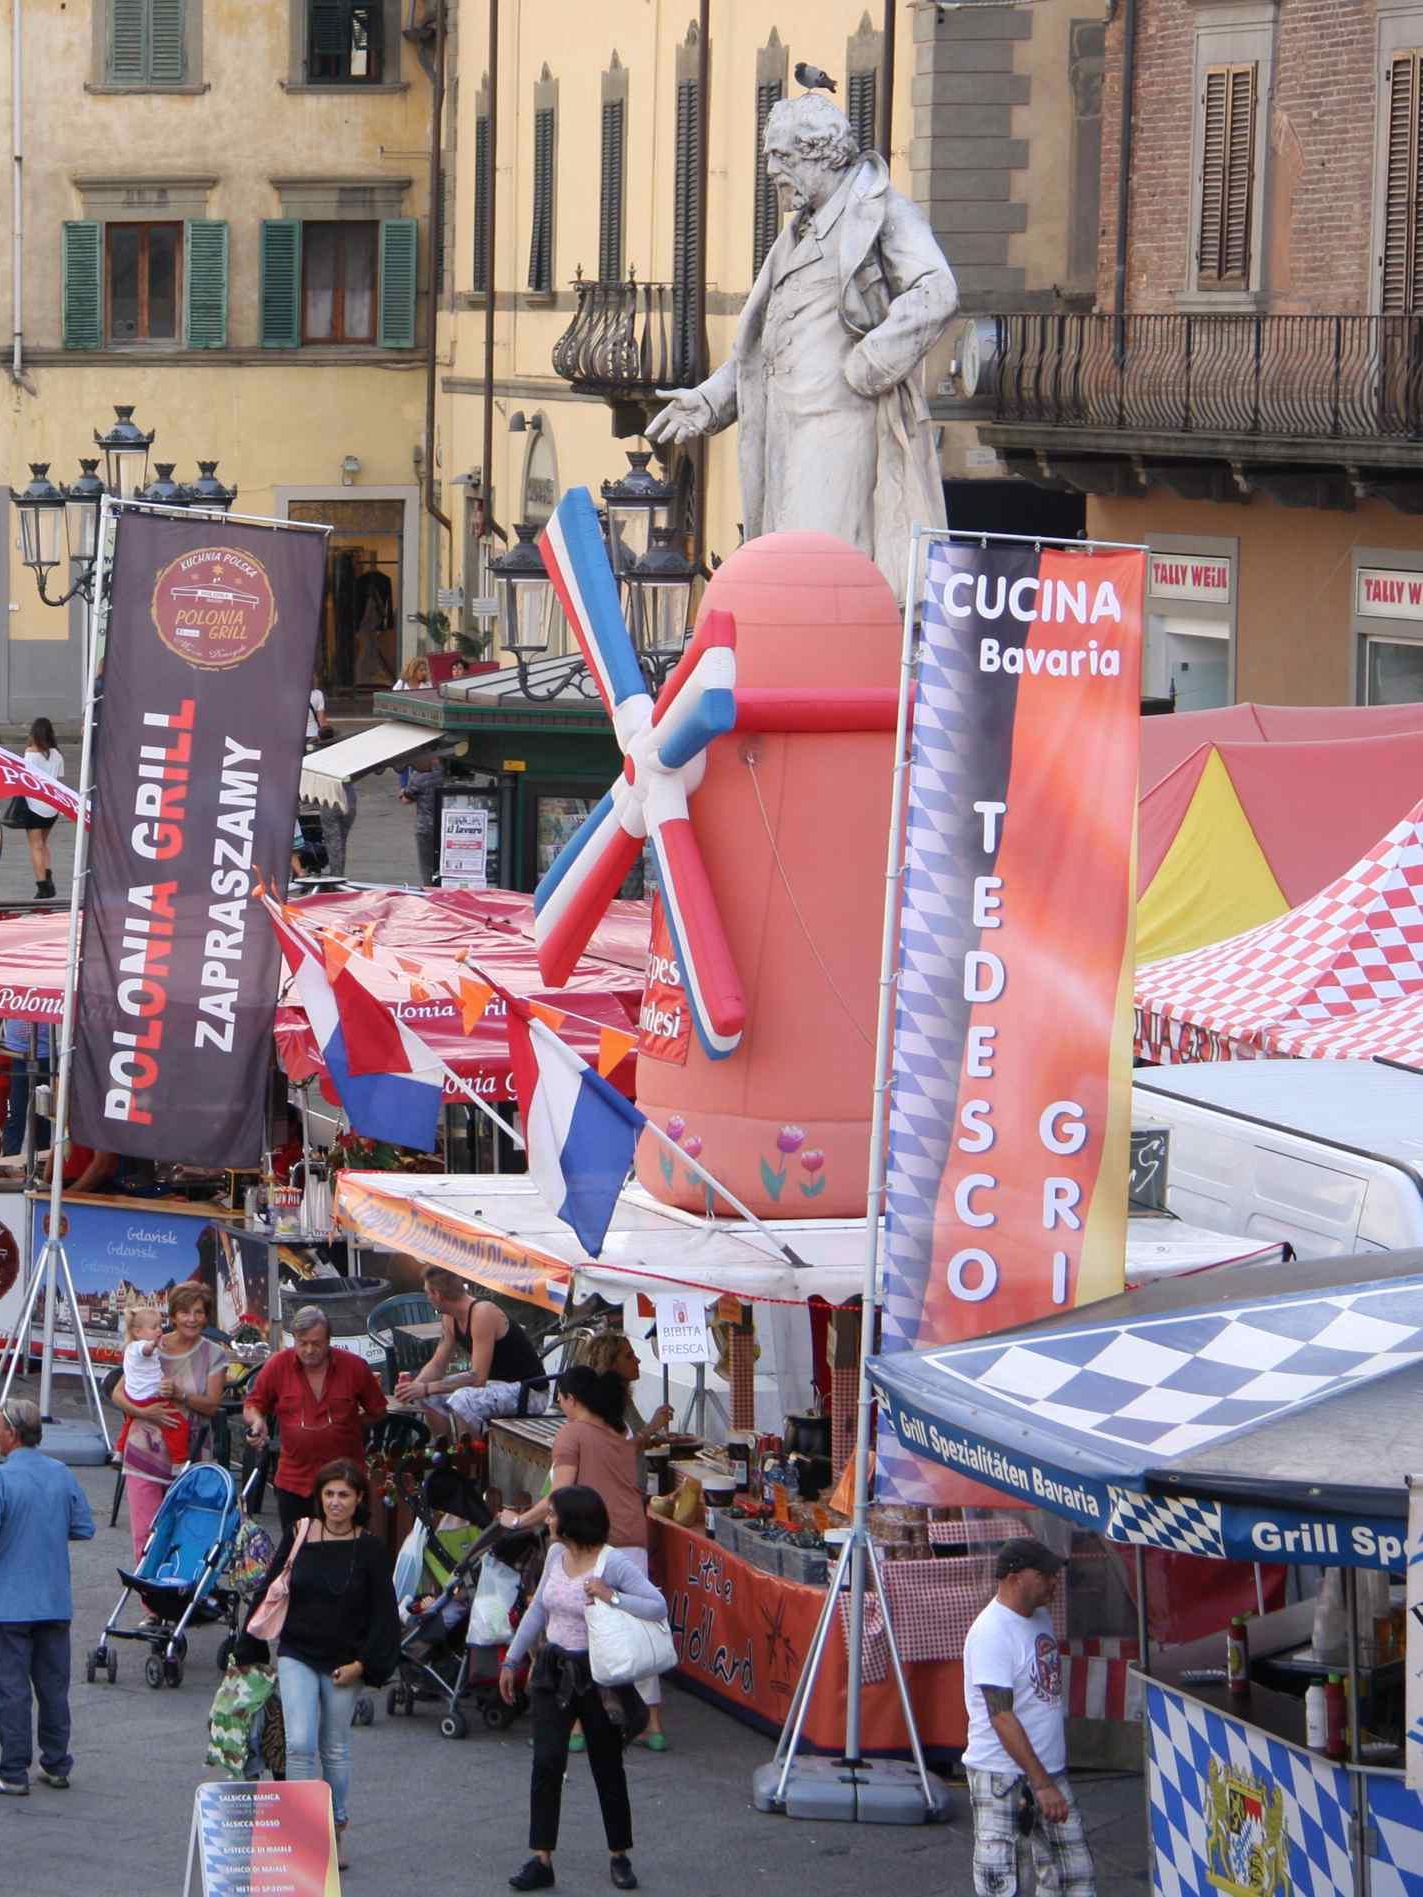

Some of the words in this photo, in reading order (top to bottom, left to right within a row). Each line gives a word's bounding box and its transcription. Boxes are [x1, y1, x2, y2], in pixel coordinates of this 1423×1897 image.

[1152, 563, 1187, 587] TALLY
[942, 573, 1122, 624] CUCINA
[1364, 579, 1405, 603] TALLY
[1408, 583, 1423, 604] W
[175, 609, 245, 625] POLONIA
[208, 625, 248, 640] GRILL
[979, 638, 1121, 676] Bavaria
[131, 698, 197, 860] GRILL
[195, 736, 263, 1053] ZAPRASZAMY
[105, 880, 179, 1125] POLONIA
[385, 1003, 456, 1019] olonia
[442, 1072, 498, 1095] lonia
[1039, 1100, 1087, 1305] GRI
[127, 1226, 178, 1244] Gdańsk
[663, 1326, 701, 1337] BIBITA
[662, 1344, 704, 1355] FRESCA
[899, 1411, 928, 1448] Grill
[929, 1424, 1030, 1491] Spezialitäten
[1032, 1466, 1100, 1518] Bavaria
[1251, 1521, 1339, 1553] Grill
[1351, 1526, 1408, 1566] Sp
